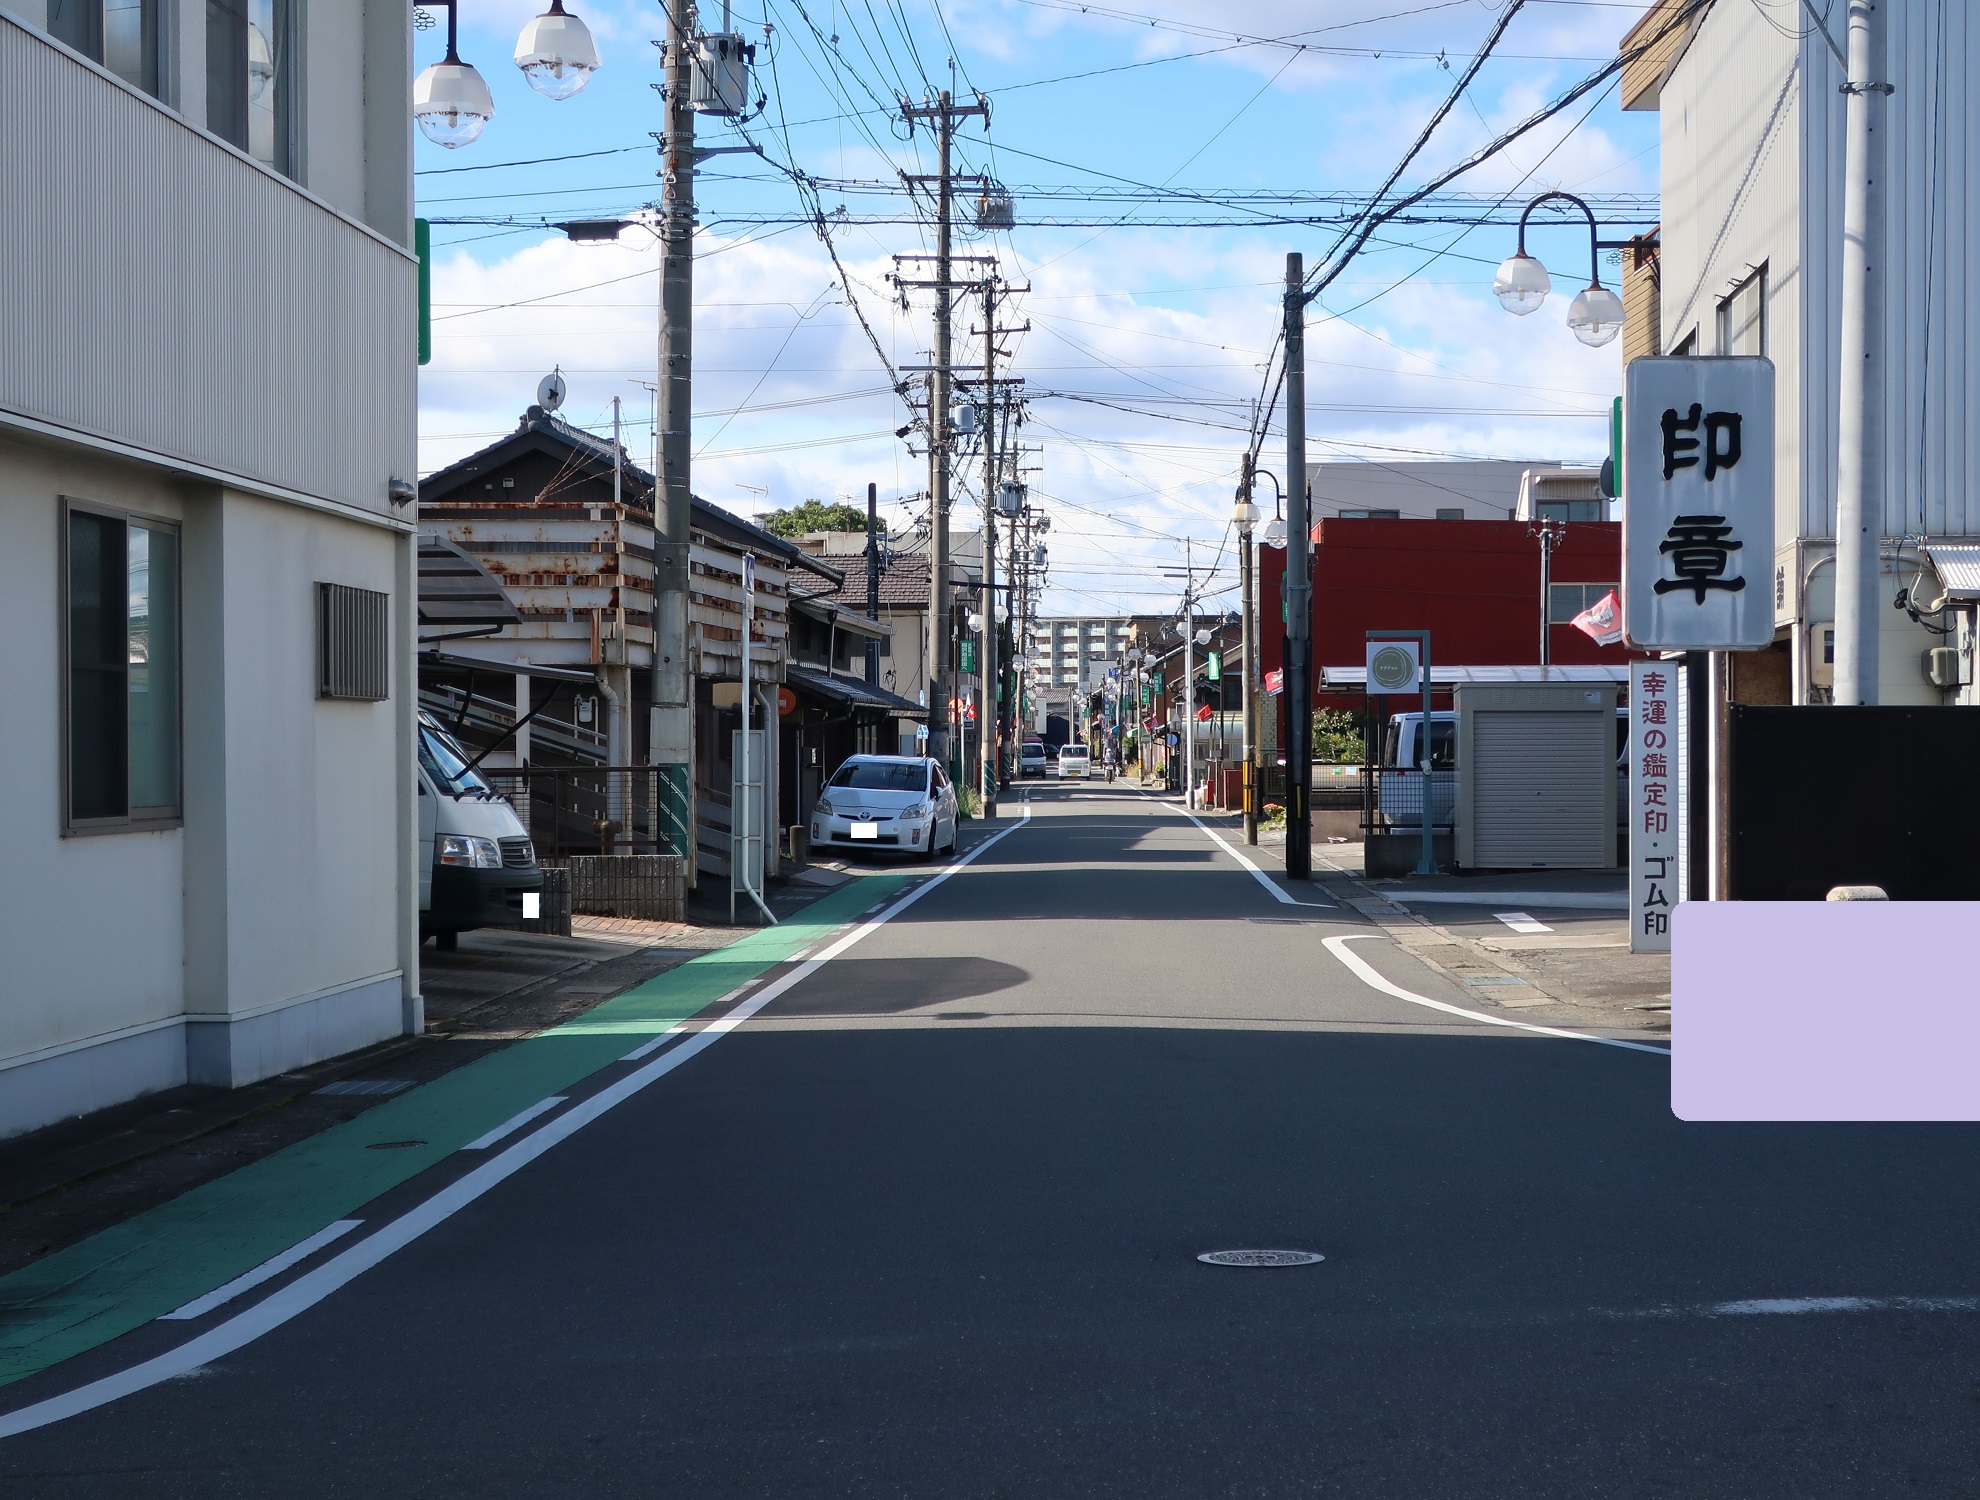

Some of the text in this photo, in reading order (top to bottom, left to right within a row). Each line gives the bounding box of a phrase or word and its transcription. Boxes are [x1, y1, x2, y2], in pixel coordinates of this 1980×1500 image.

[1653, 402, 1746, 606] 印章
[1641, 671, 1675, 936] 幸運の鑑定印・ゴム印
